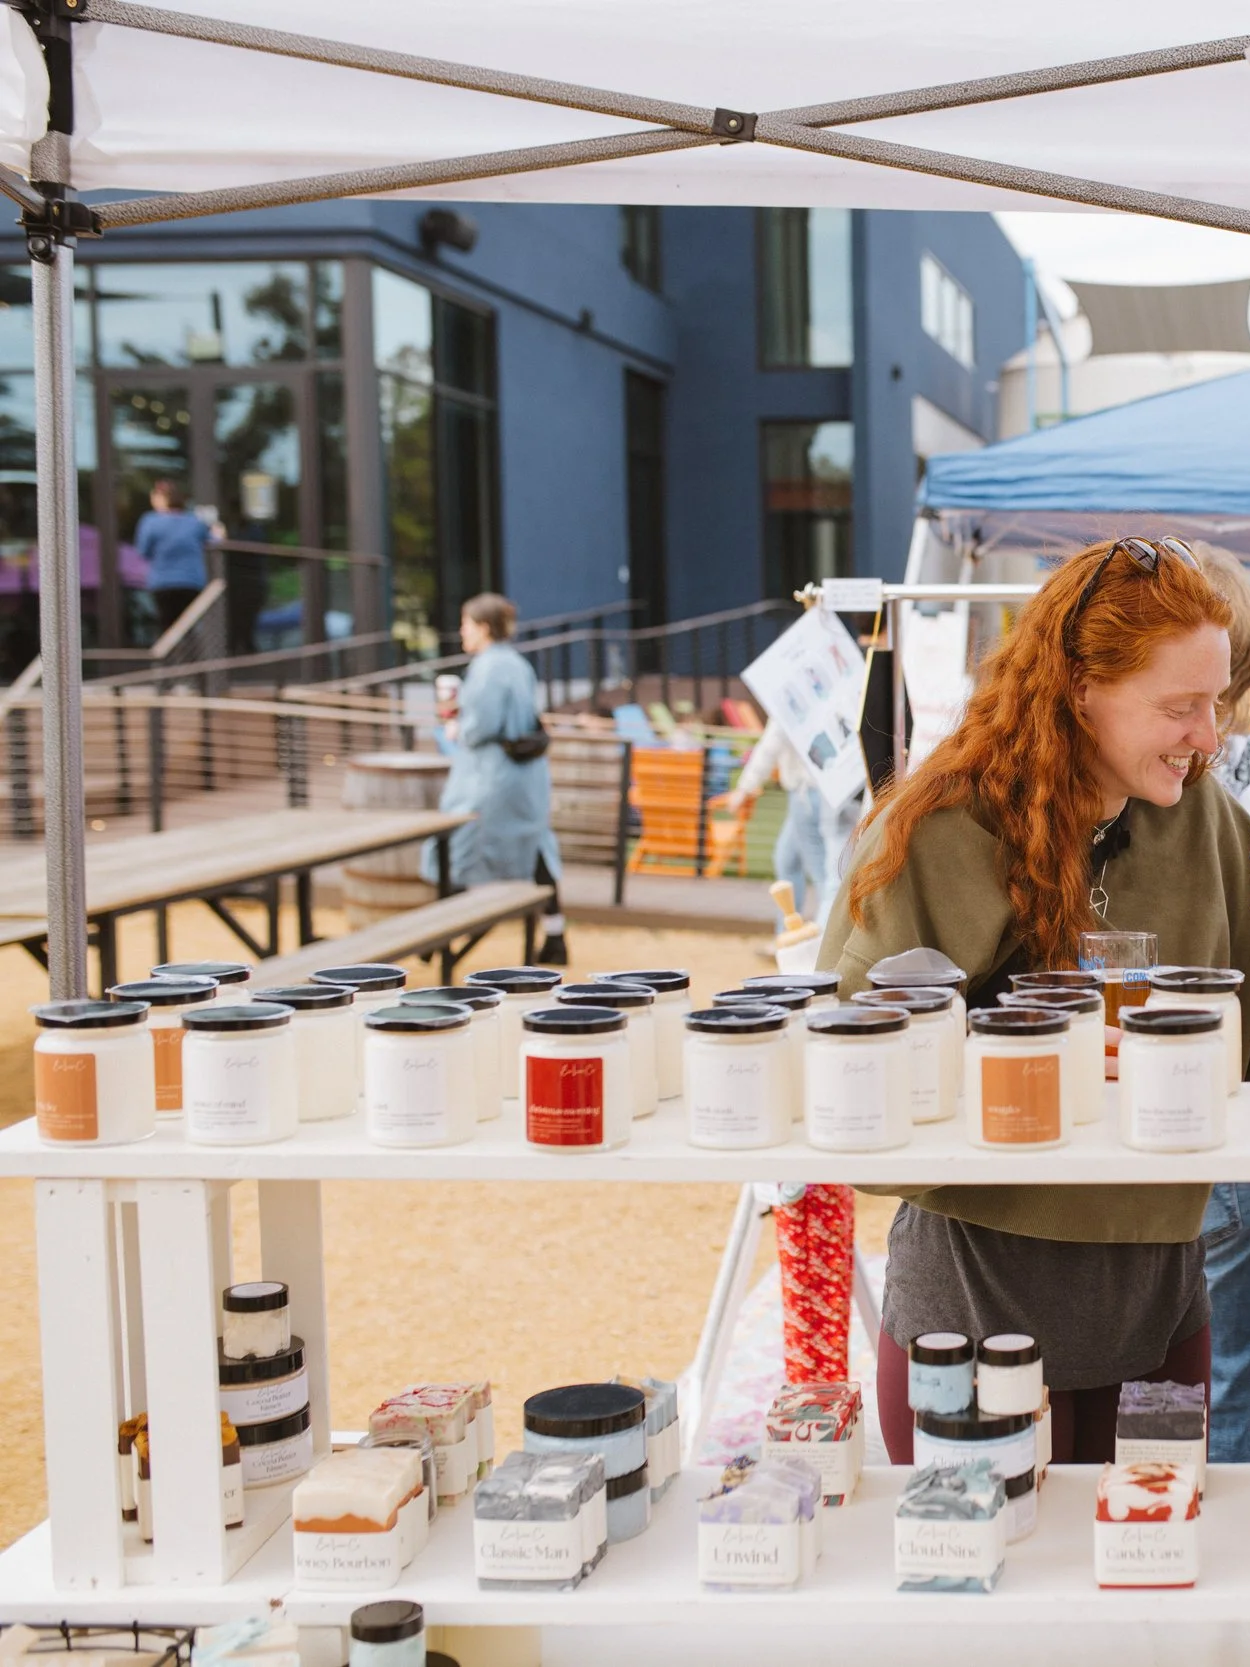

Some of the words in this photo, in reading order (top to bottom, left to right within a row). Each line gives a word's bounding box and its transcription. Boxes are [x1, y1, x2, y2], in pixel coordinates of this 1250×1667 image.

[1126, 973, 1148, 982] COM
[481, 1543, 533, 1560] Classic
[535, 1544, 570, 1560] Man
[714, 1546, 779, 1565] Unwind
[898, 1540, 944, 1557] Cloud
[947, 1543, 981, 1559] Nine
[1105, 1546, 1147, 1563] Candy
[1149, 1548, 1185, 1560] Cane
[333, 1555, 392, 1570] Bourbon
